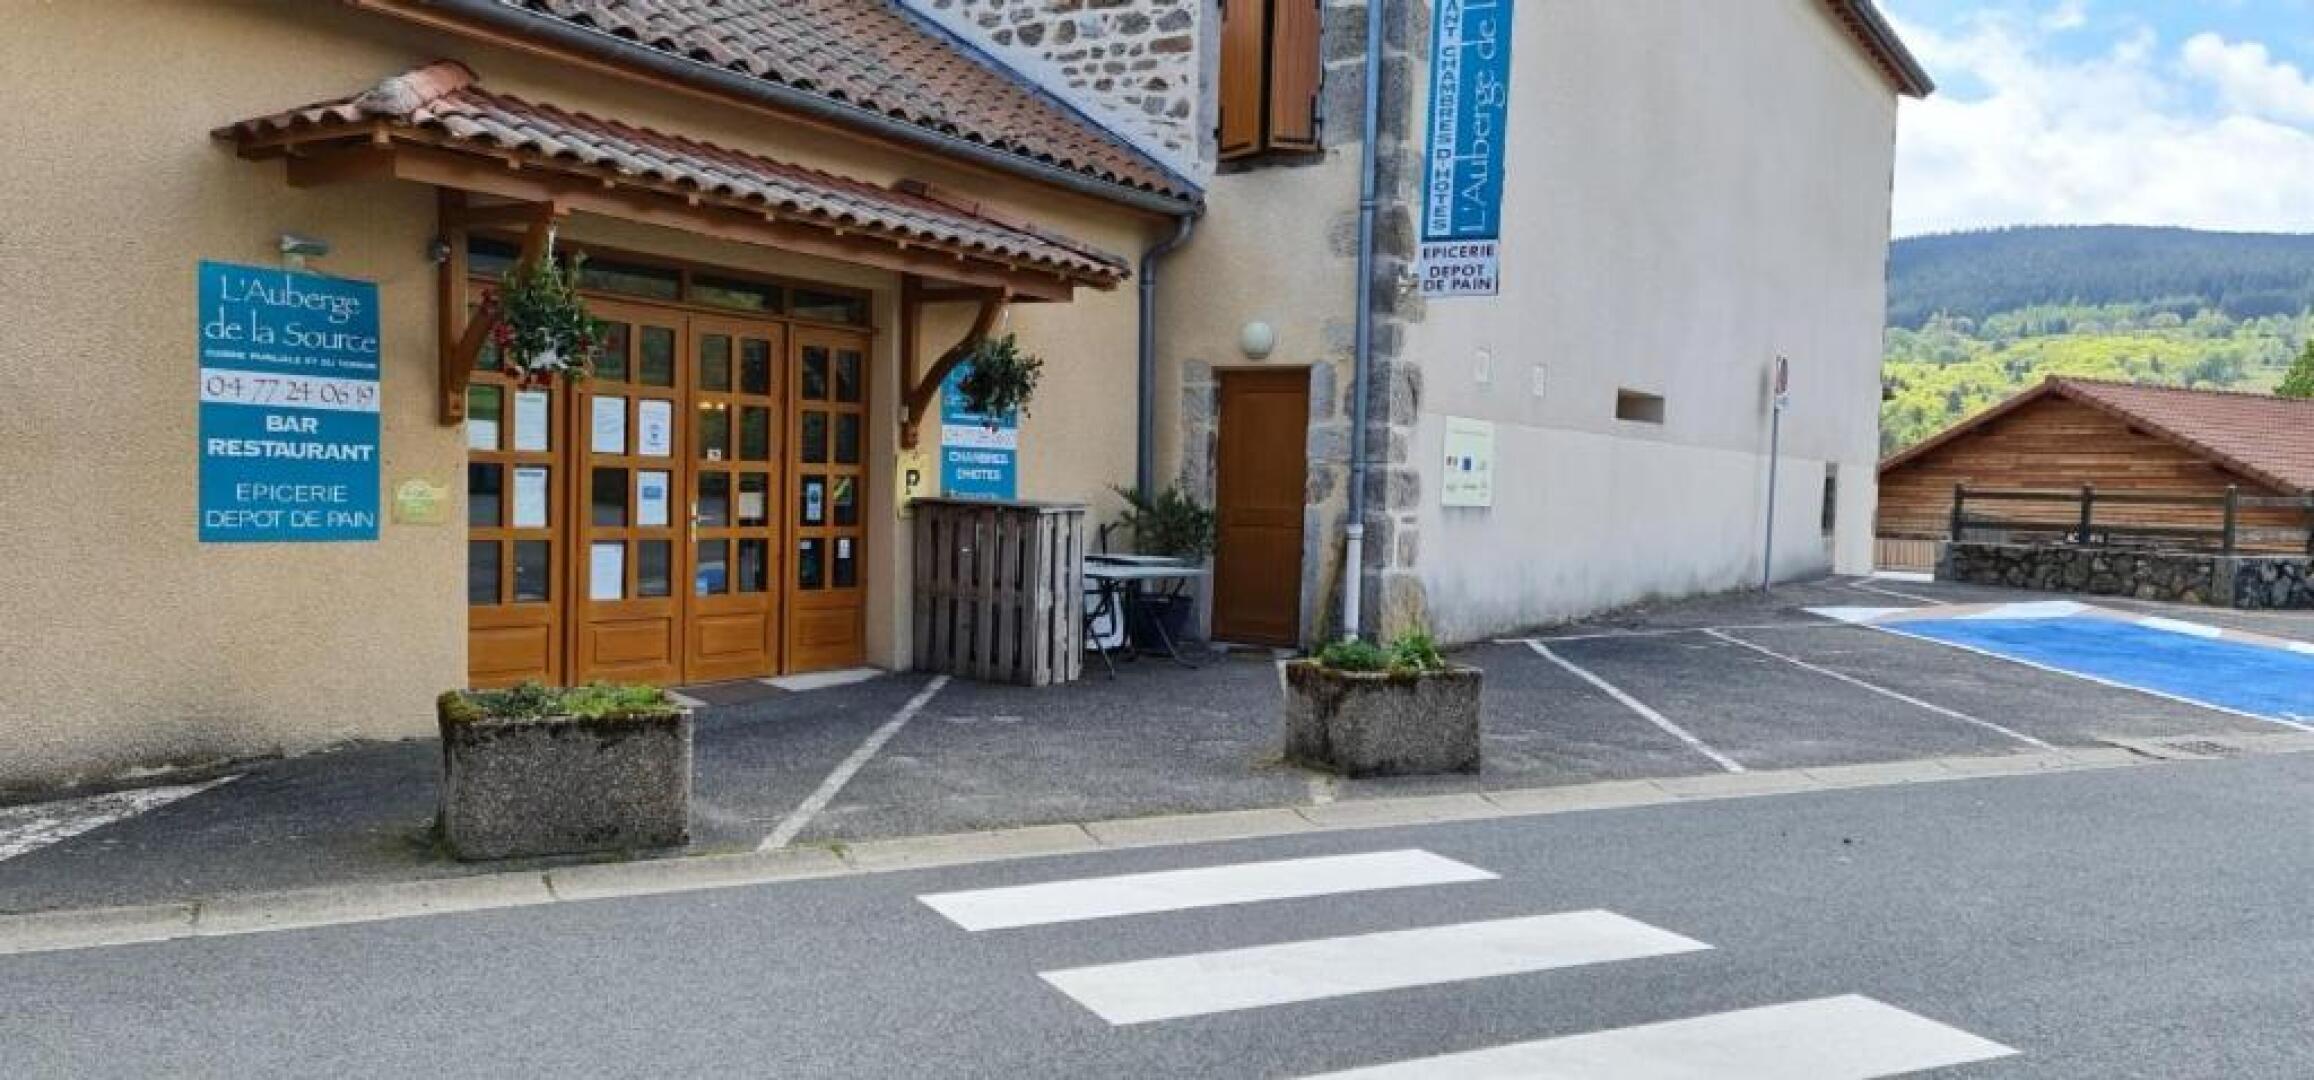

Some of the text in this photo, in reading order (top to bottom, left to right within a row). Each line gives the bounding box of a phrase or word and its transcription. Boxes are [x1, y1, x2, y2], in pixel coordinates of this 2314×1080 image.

[1461, 19, 1497, 60] de
[1438, 46, 1458, 143] CHAMBRES
[1453, 70, 1505, 232] L'Auberge
[1423, 244, 1494, 260] EPICERIE
[1429, 264, 1486, 279] DEPOT
[1423, 277, 1492, 292] DE PAIN
[221, 273, 361, 324] L'Auberge
[205, 305, 377, 353] de la Source
[207, 375, 242, 398] 04
[252, 378, 280, 402] 77
[286, 380, 314, 402] 24
[266, 415, 319, 435] BAR
[207, 437, 374, 462] RESTAURANT
[236, 483, 349, 503] EPICERIE
[206, 509, 375, 529] DEPOT DE PAIN
